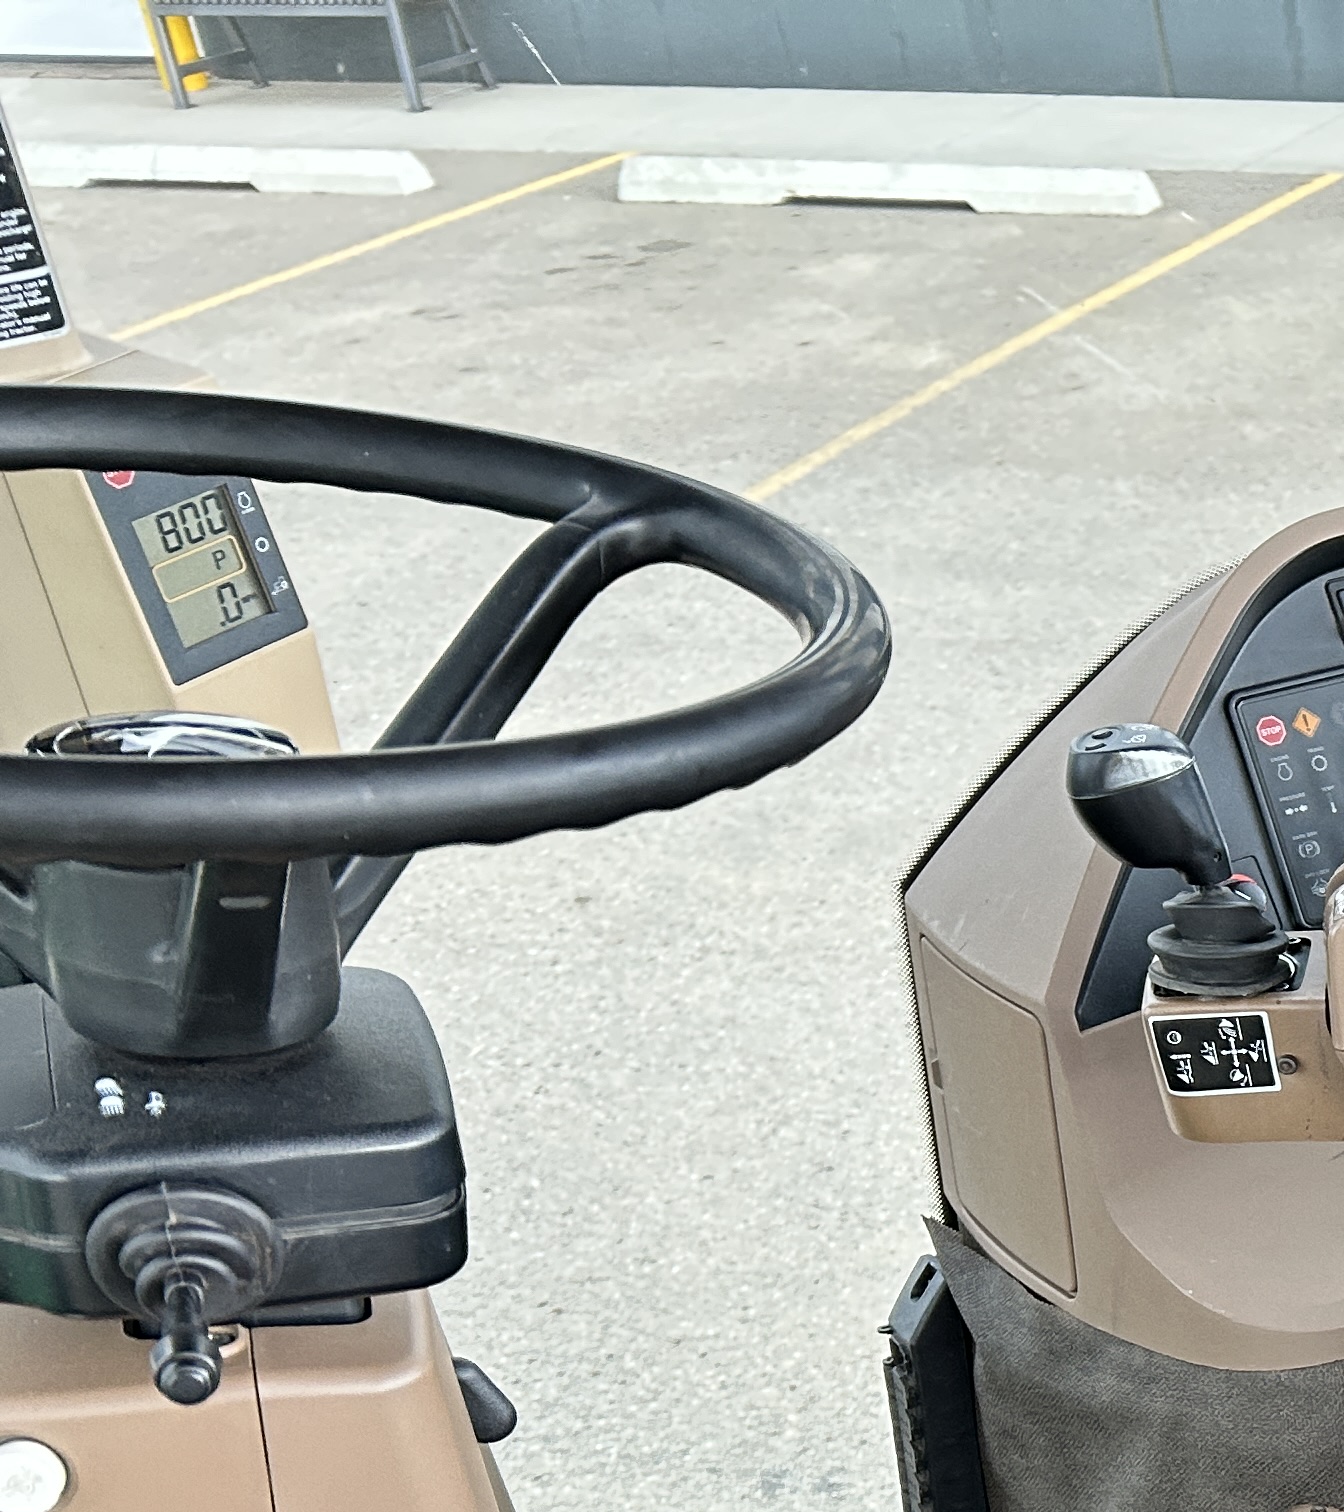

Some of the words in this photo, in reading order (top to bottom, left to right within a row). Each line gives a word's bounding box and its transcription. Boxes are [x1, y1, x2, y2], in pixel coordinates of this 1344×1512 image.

[155, 493, 227, 553] 800
[212, 549, 226, 570] P
[1261, 725, 1282, 737] STOP
